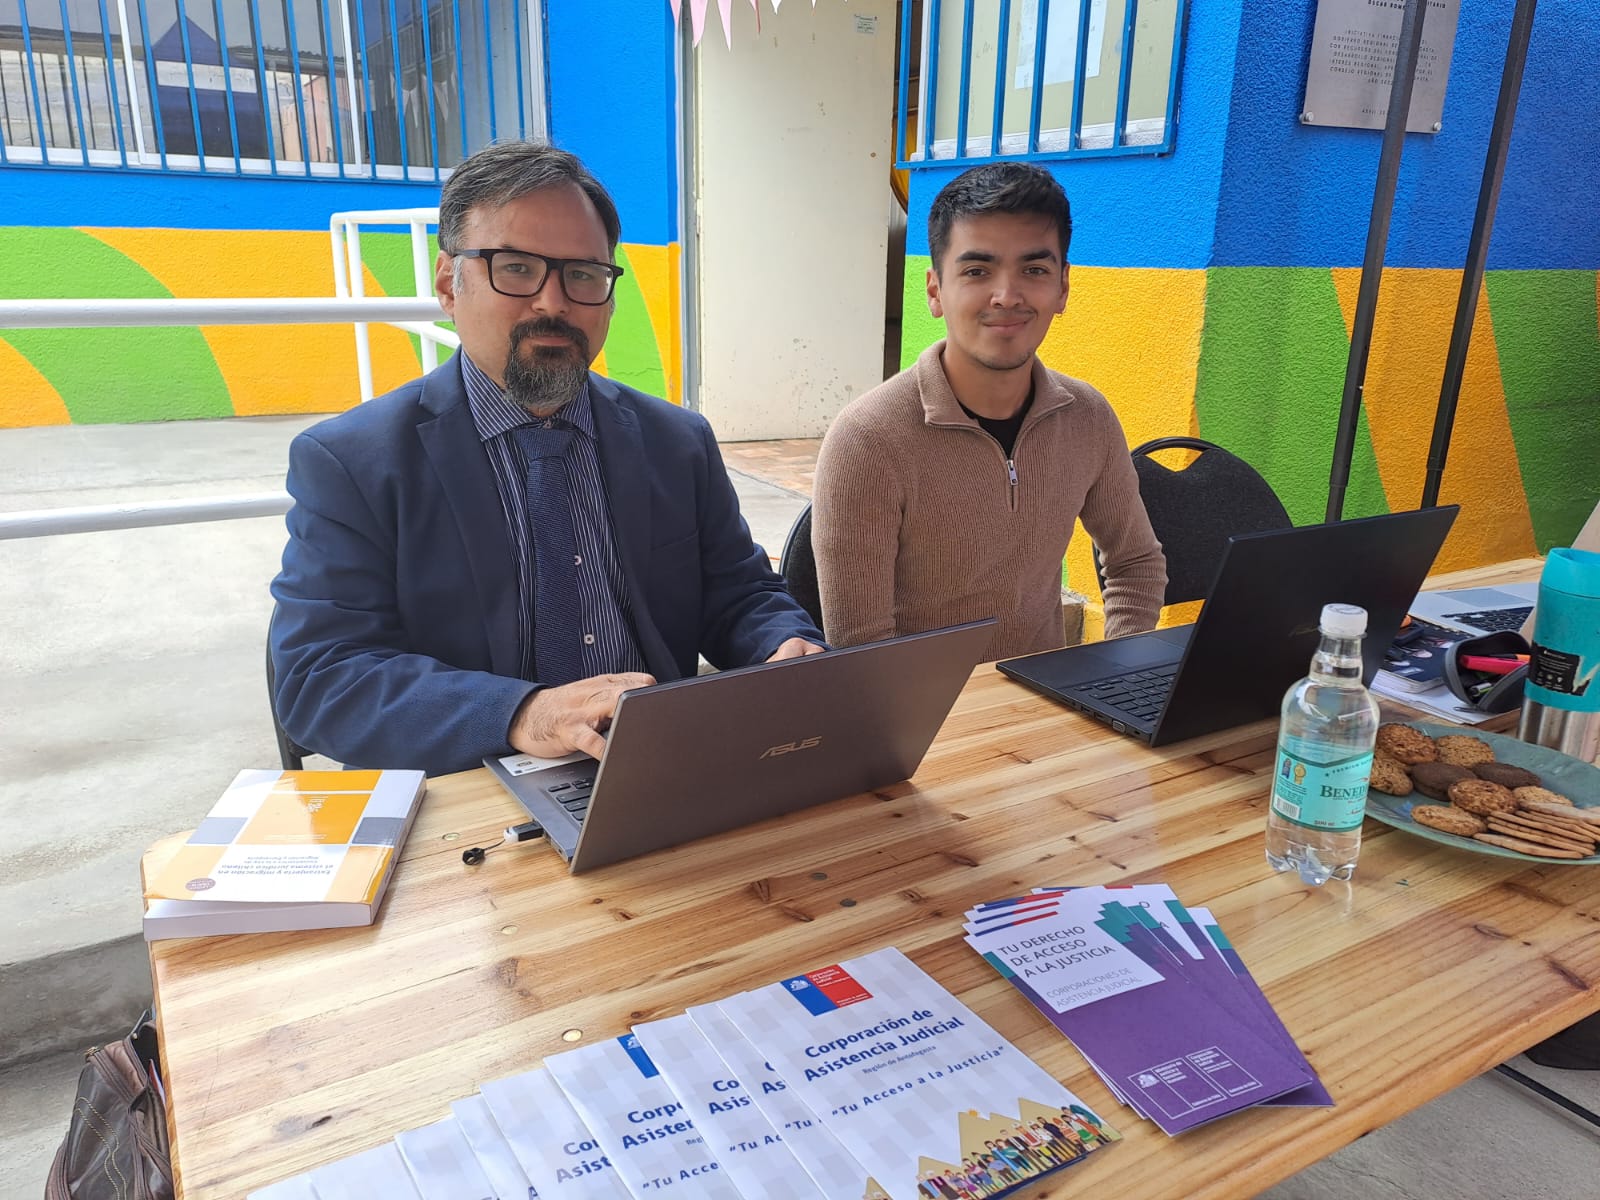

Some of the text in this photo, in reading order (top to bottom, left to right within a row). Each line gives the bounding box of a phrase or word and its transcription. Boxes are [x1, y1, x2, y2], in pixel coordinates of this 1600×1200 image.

[759, 736, 822, 760] ASUS
[997, 926, 1085, 955] TU DERECHO
[1010, 939, 1087, 967] DE ACCESO
[1023, 945, 1116, 978] A LA JUSTICIA
[1046, 970, 1120, 998] CORPORACIONES
[1056, 986, 1106, 1007] ASISTENCIA
[805, 1009, 934, 1058] Corporación de
[804, 1016, 965, 1082] Asistencia Judicial
[862, 1081, 913, 1106] Acceso
[927, 1071, 944, 1080] la
[627, 1101, 683, 1123] Corp
[708, 1095, 751, 1115] Asis
[556, 1156, 612, 1184] Asist
[679, 1162, 719, 1181] Acce
